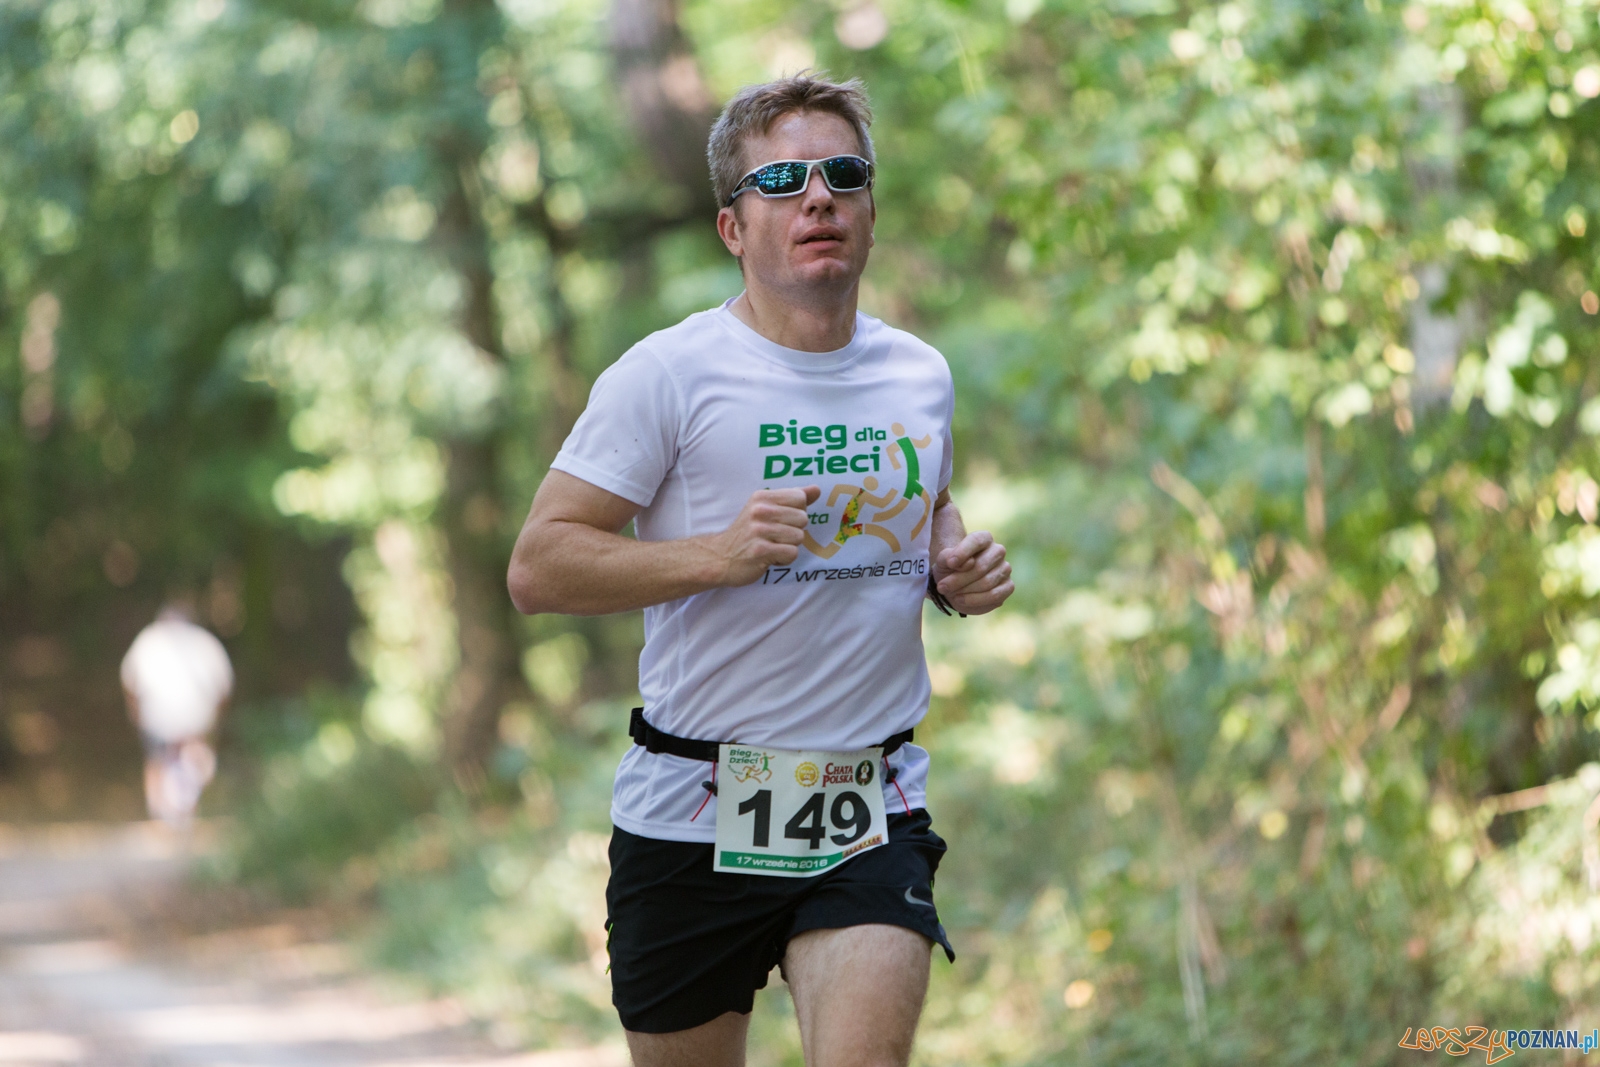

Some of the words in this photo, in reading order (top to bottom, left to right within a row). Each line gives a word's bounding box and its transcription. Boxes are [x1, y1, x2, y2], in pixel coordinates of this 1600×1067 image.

[759, 419, 847, 450] Bieg
[855, 427, 886, 442] dla
[763, 446, 880, 480] Dzieci
[763, 568, 791, 585] 17
[795, 562, 885, 583] września
[888, 559, 925, 576] 2016
[729, 749, 752, 758] Bieg
[825, 762, 853, 775] CHATA
[822, 774, 854, 788] POLSKA
[738, 789, 871, 850] 149
[736, 856, 753, 865] 17
[799, 858, 828, 869] 2016
